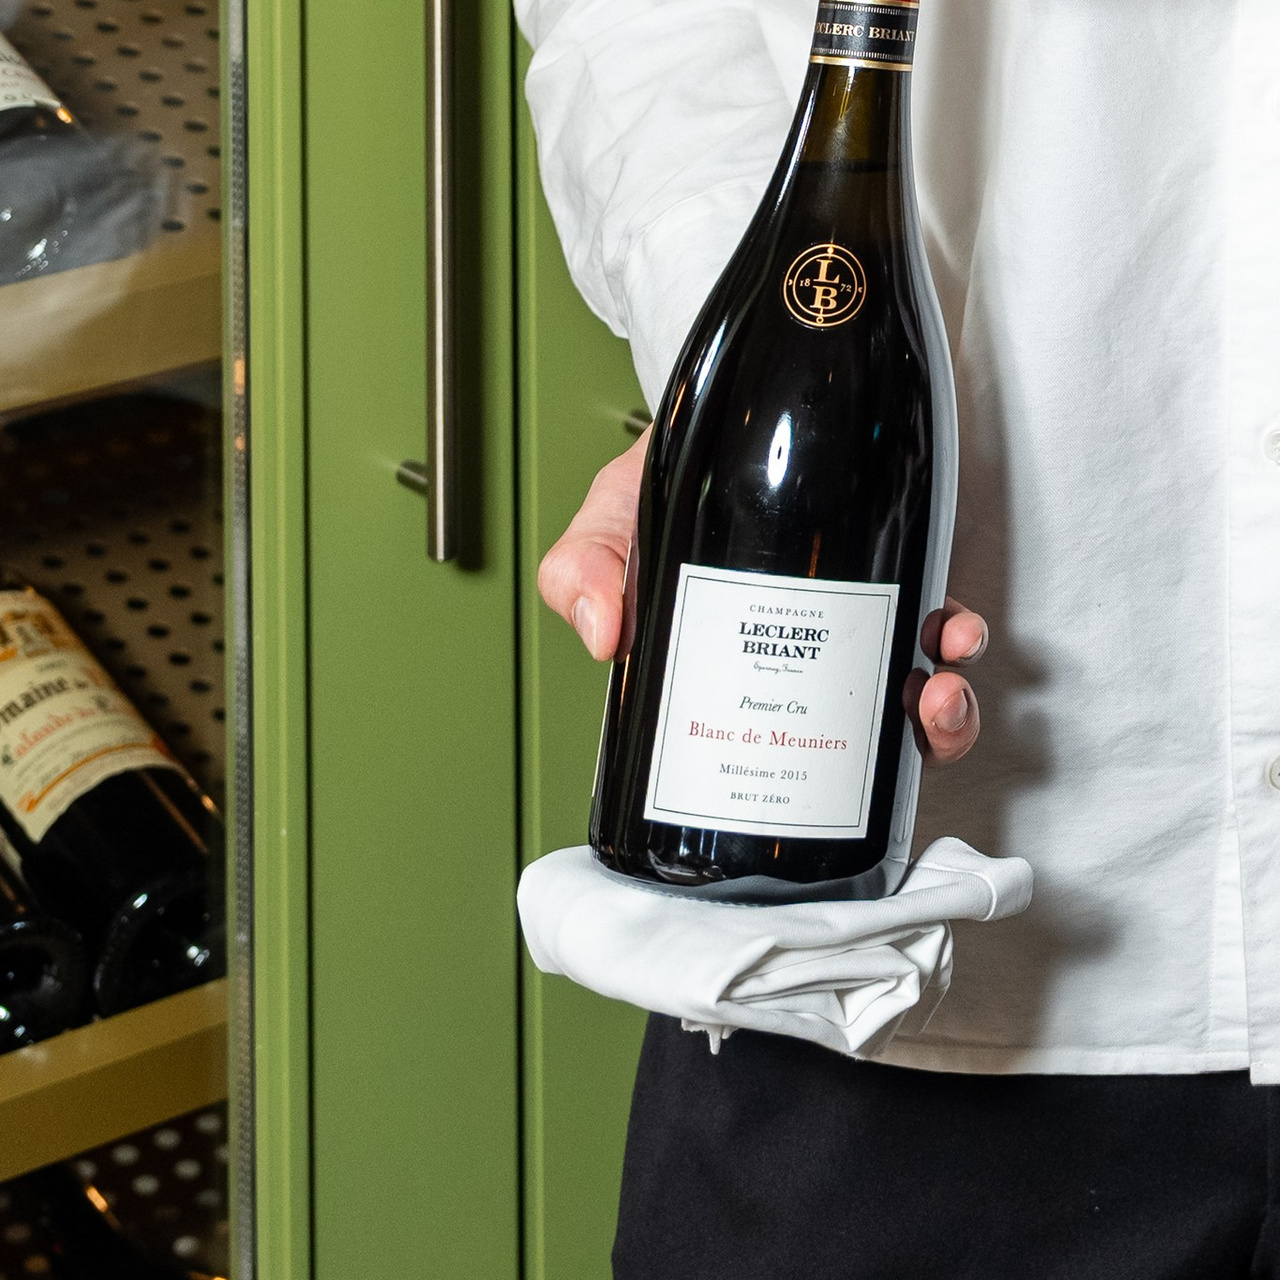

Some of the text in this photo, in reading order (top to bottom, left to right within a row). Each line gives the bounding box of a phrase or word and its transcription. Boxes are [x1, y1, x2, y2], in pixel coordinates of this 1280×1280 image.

[868, 26, 915, 42] BRIANT
[749, 604, 824, 619] CHAMPAGNE
[739, 621, 830, 642] LECLERC
[742, 640, 820, 660] BRIANT
[739, 696, 808, 715] Premier Cru
[688, 720, 848, 750] Blanc de Meuniers
[719, 763, 808, 781] Millésime 2015
[730, 791, 790, 804] BRUT ZÉRO
